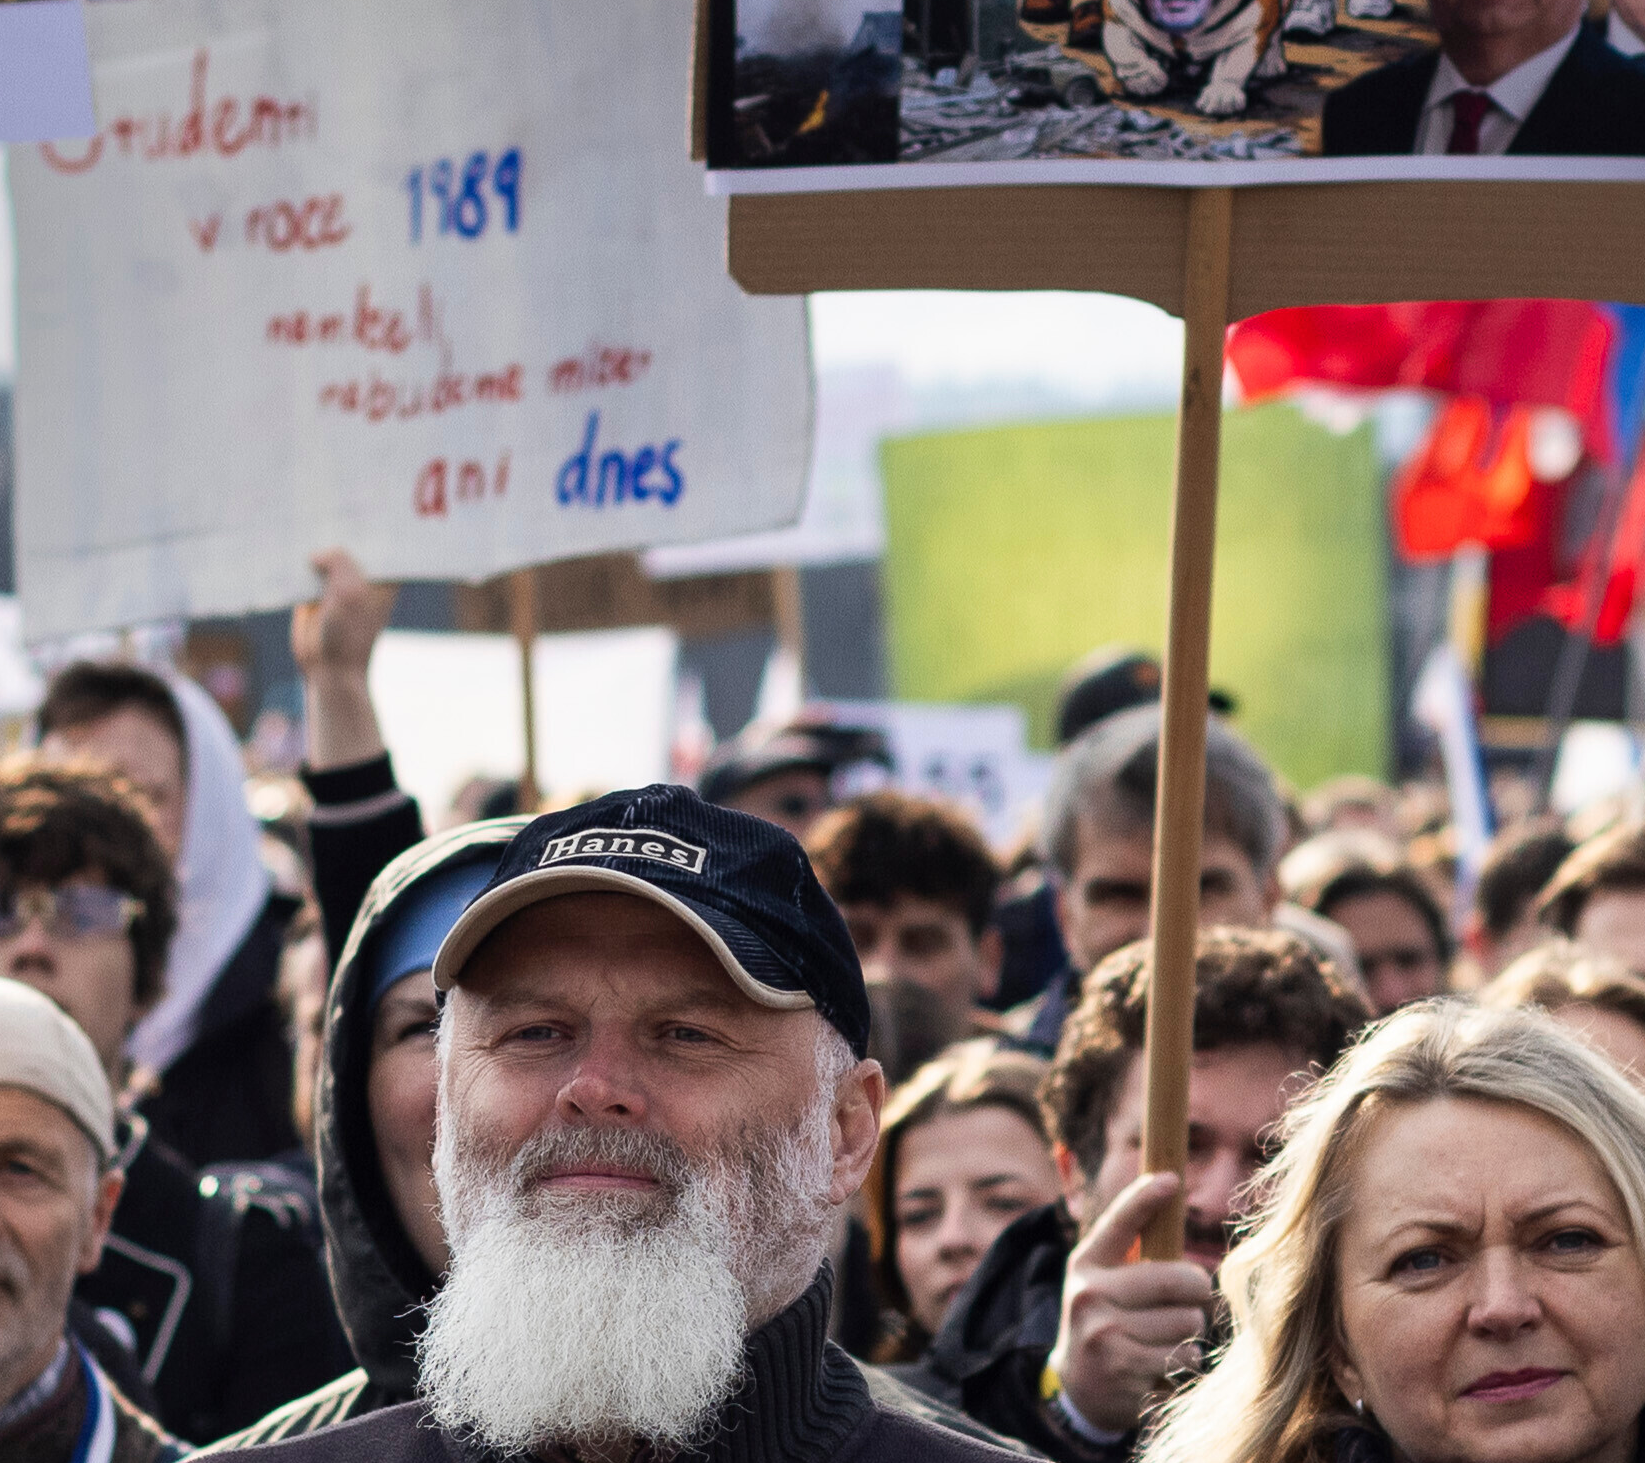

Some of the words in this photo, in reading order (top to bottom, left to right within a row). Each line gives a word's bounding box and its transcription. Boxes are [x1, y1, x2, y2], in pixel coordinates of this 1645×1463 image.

[189, 207, 223, 253] v
[243, 190, 354, 255] roce
[400, 144, 524, 249] 1989
[411, 448, 513, 520] ani
[556, 408, 686, 511] dnes
[550, 835, 690, 865] Hanes
